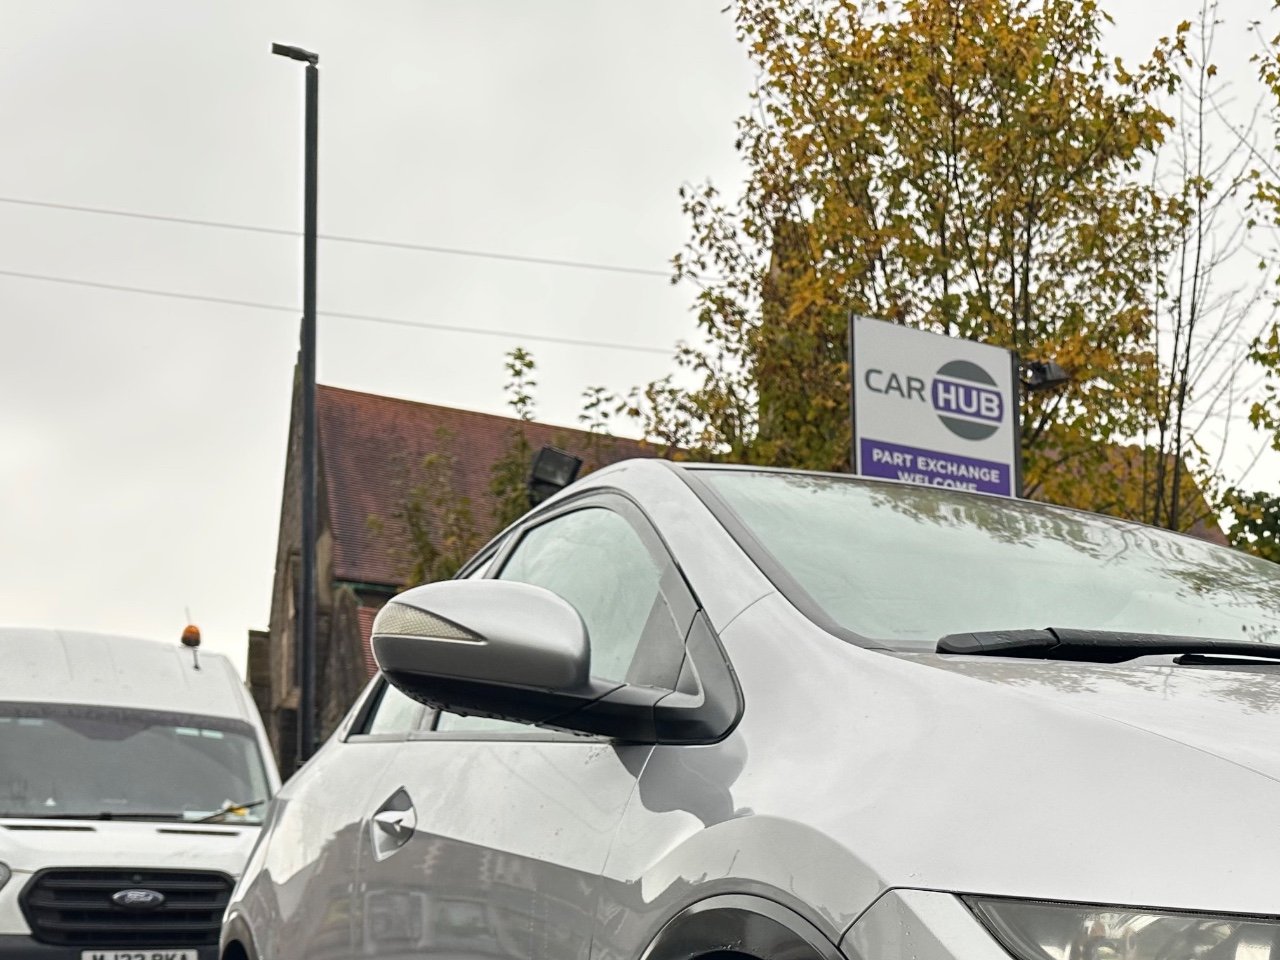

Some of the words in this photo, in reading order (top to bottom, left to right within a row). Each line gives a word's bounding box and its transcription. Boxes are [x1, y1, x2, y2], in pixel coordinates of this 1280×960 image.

[865, 369, 925, 402] CAR
[937, 382, 1000, 417] HUB
[872, 448, 912, 468] PART
[917, 456, 1000, 483] EXCHANGE
